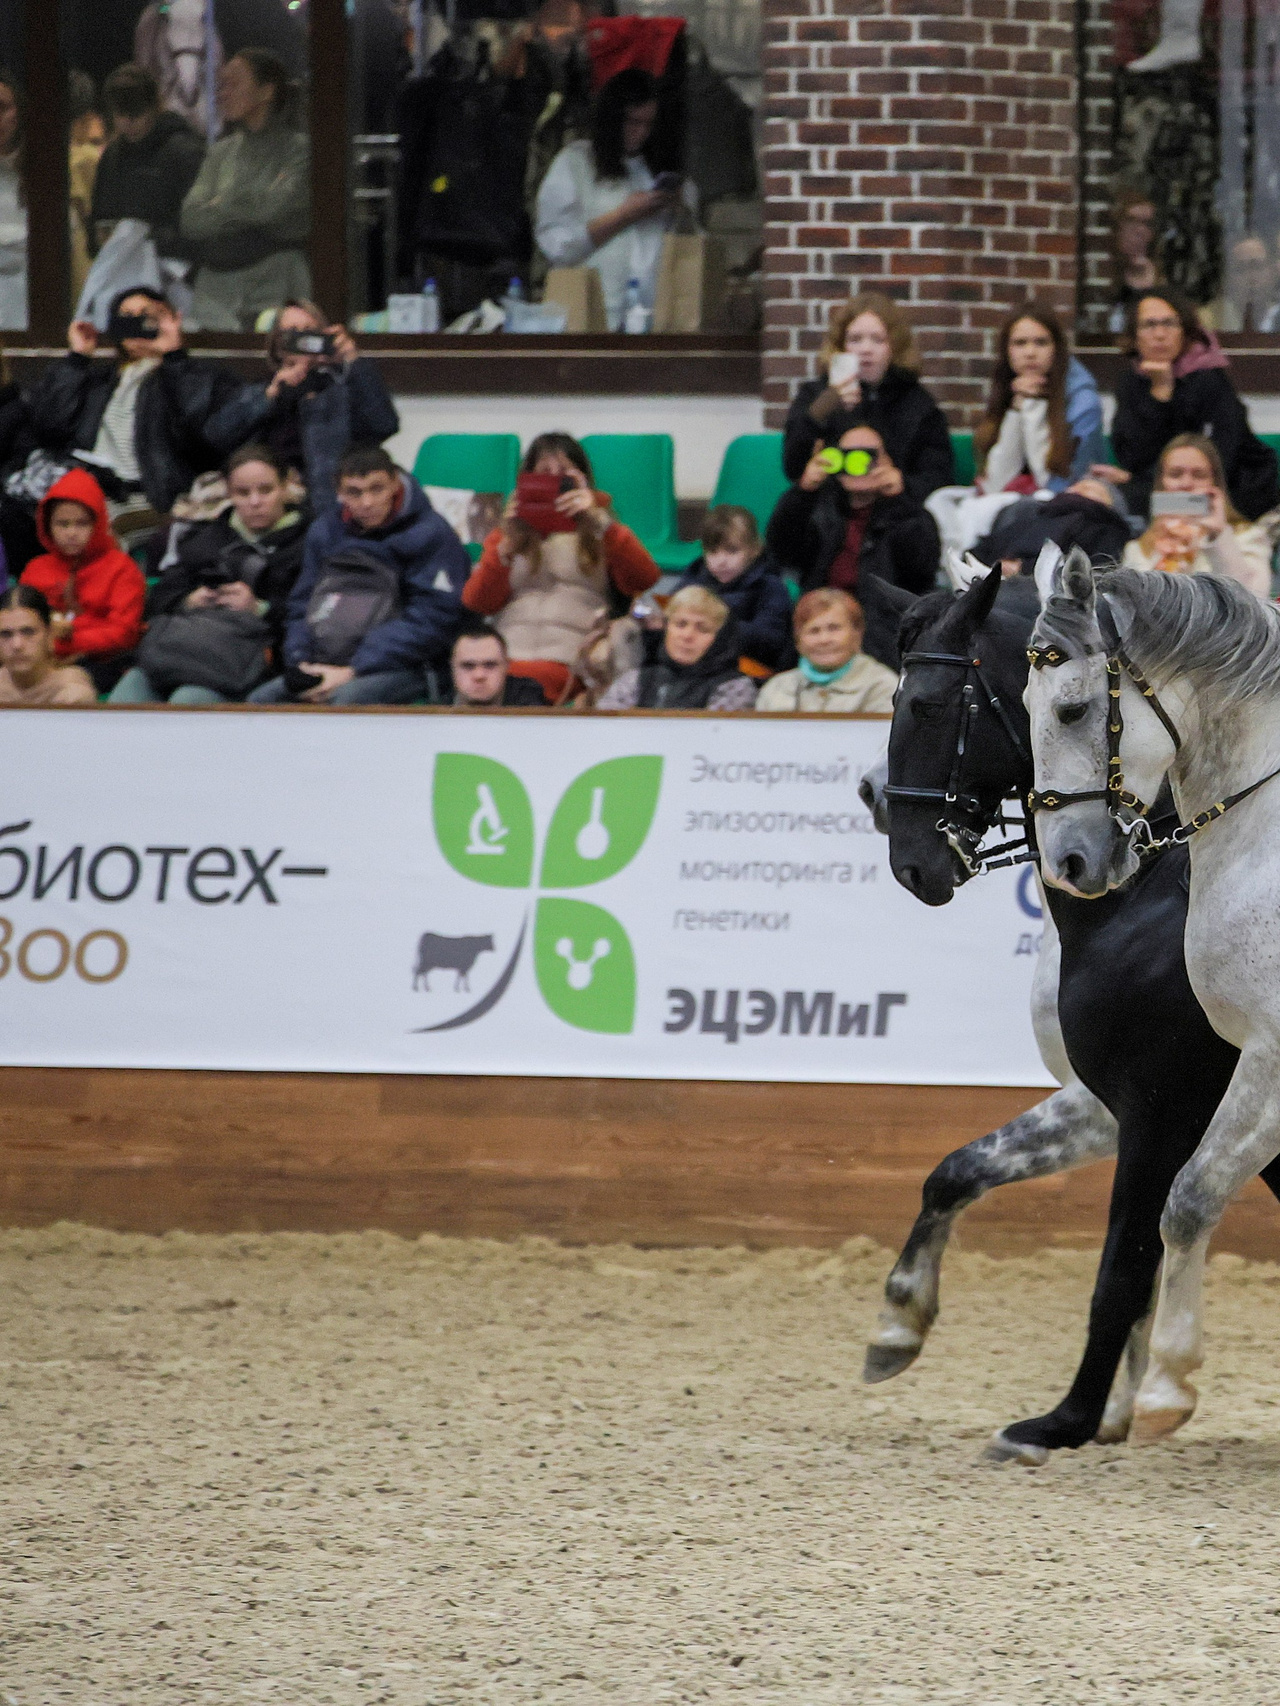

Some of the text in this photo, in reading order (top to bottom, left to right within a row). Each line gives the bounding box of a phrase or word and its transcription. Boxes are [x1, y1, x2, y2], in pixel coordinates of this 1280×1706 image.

[690, 754, 850, 790] Экспертный
[684, 809, 877, 834] эпизоотическо
[680, 860, 878, 889] мониторинга и
[673, 908, 790, 932] генетики
[663, 988, 908, 1044] ЭЦЭМиГ
